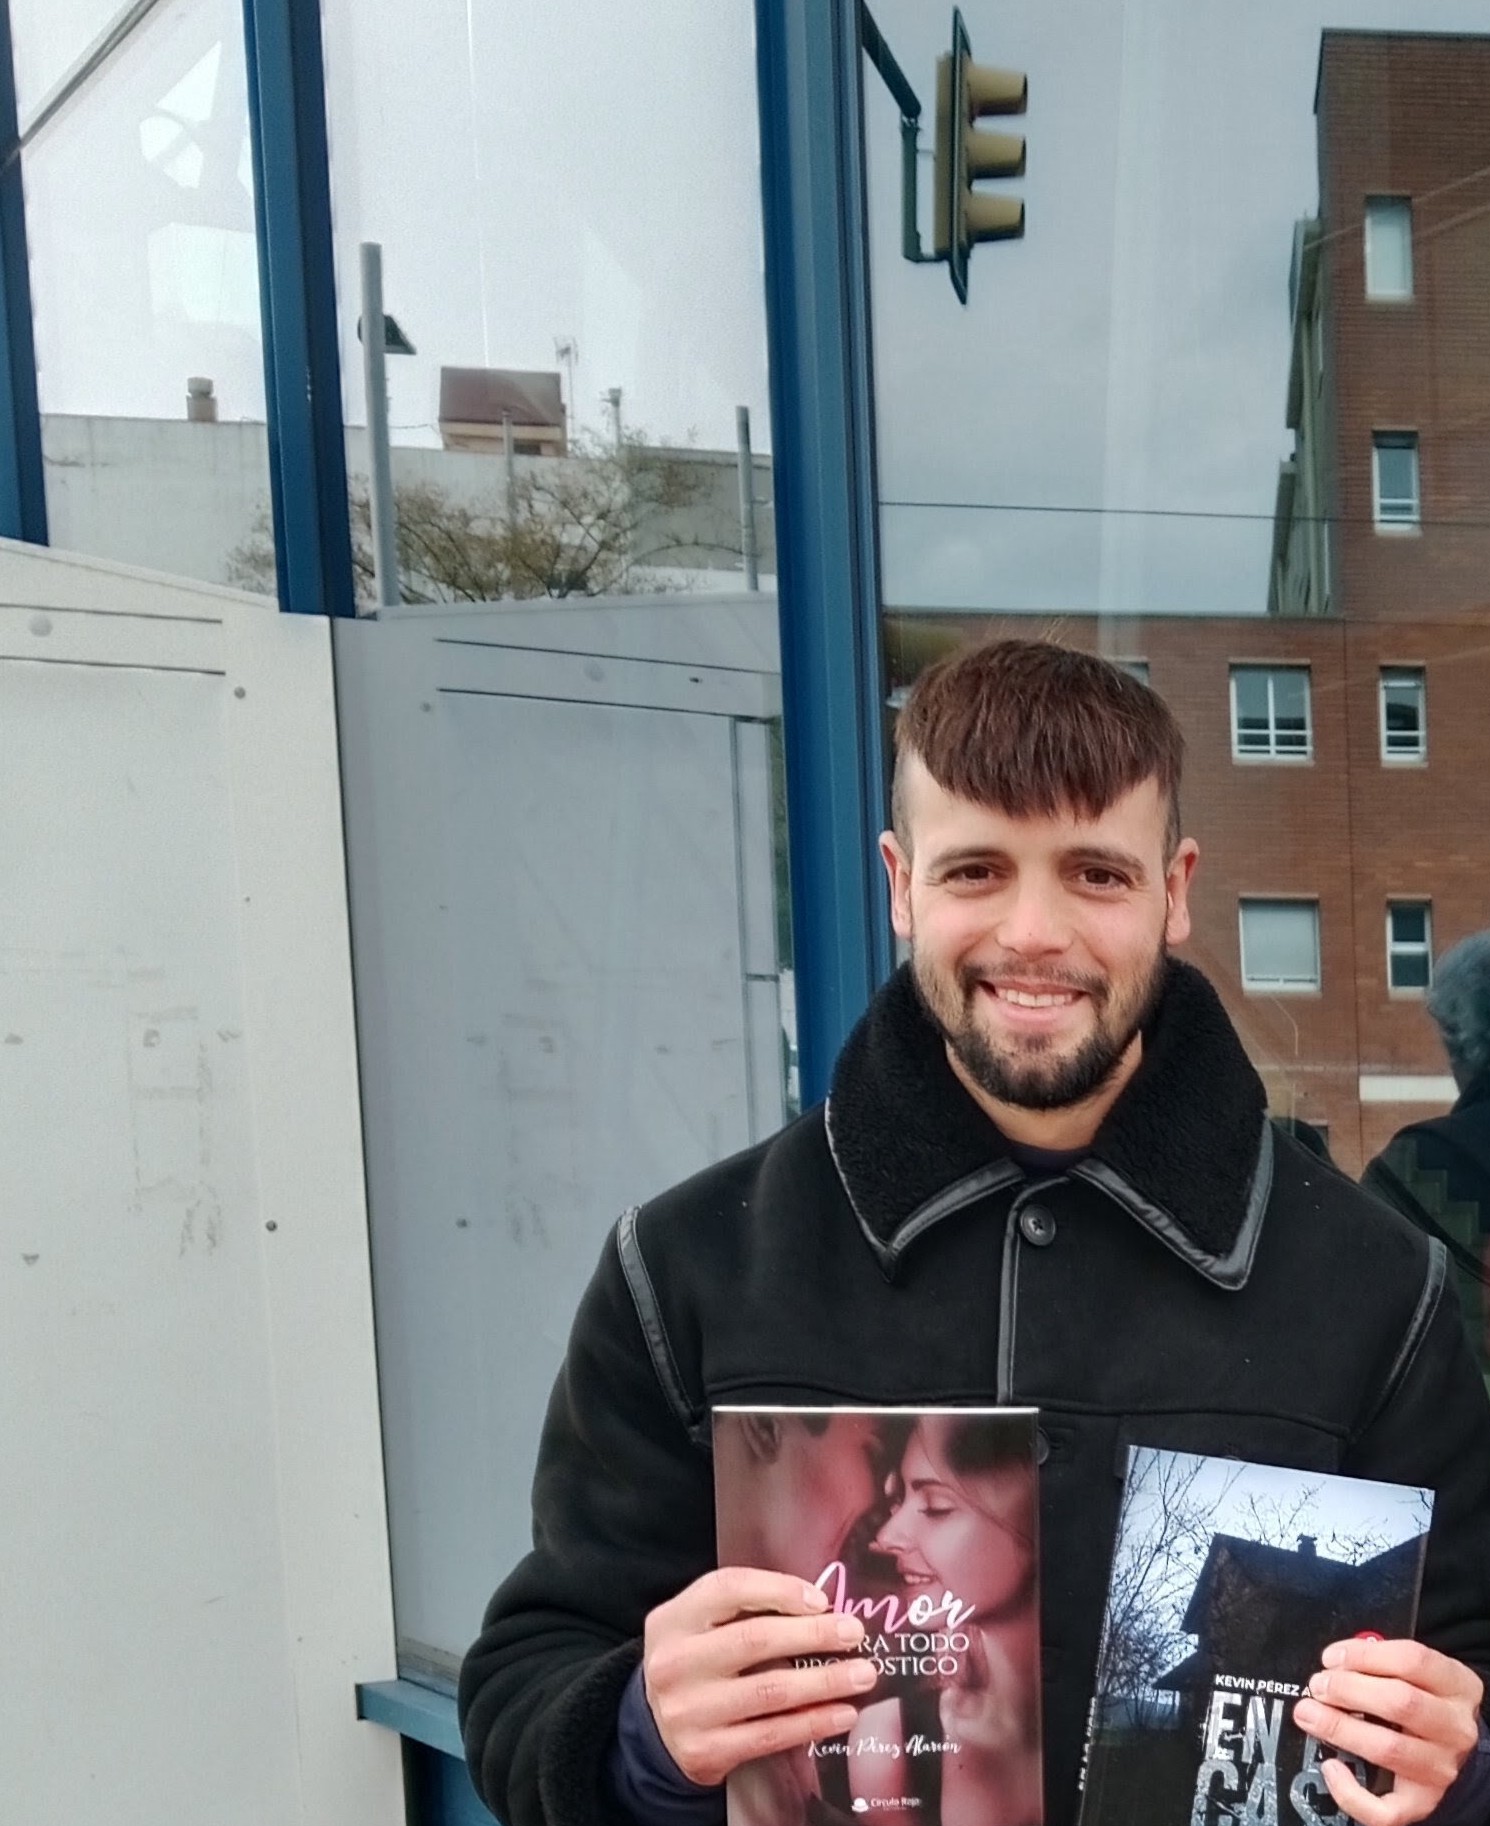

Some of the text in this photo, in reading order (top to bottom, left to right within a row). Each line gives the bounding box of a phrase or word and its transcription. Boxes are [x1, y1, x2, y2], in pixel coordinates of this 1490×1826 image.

[813, 1561, 976, 1633] Amor
[895, 1632, 969, 1653] TODO
[1215, 1673, 1255, 1690] KEVIN
[1257, 1679, 1299, 1698] PÉREZ
[1202, 1690, 1284, 1764] EN
[808, 1739, 852, 1758] Kevin
